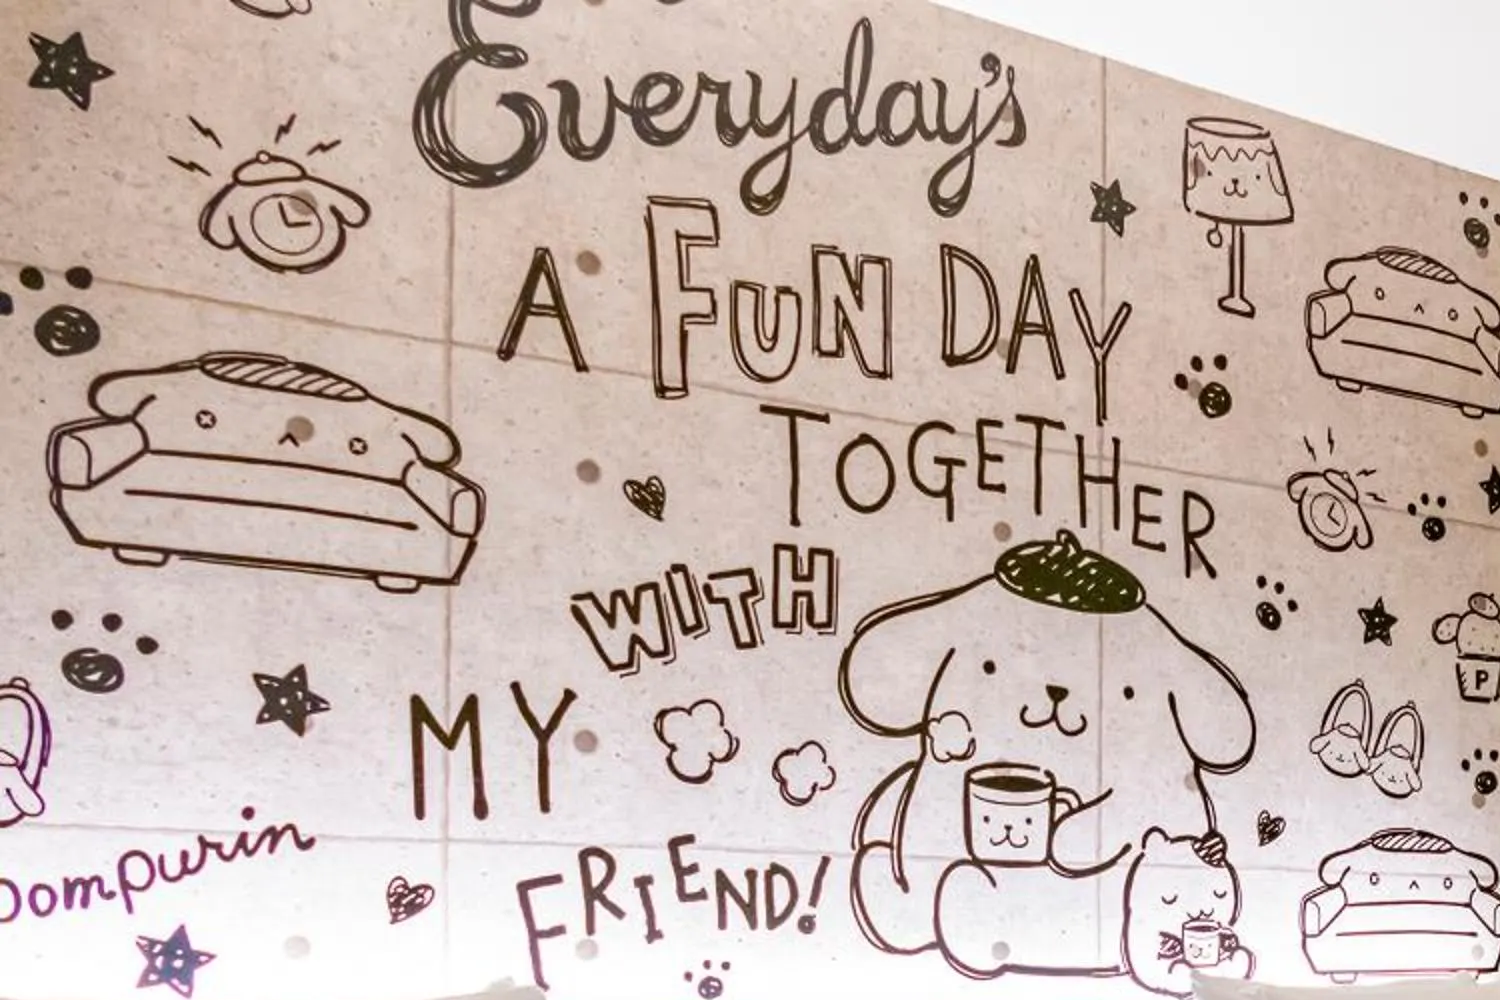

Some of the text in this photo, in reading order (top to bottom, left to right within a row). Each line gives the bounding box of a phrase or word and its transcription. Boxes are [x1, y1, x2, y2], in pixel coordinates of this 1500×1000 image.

[412, 0, 1027, 214] Everyday's
[497, 195, 1132, 426] A FUN DAY
[760, 403, 1217, 580] TOGETHER
[571, 541, 839, 676] WITH
[1475, 669, 1489, 690] P
[409, 681, 577, 820] MY
[516, 833, 832, 991] FRIEND!
